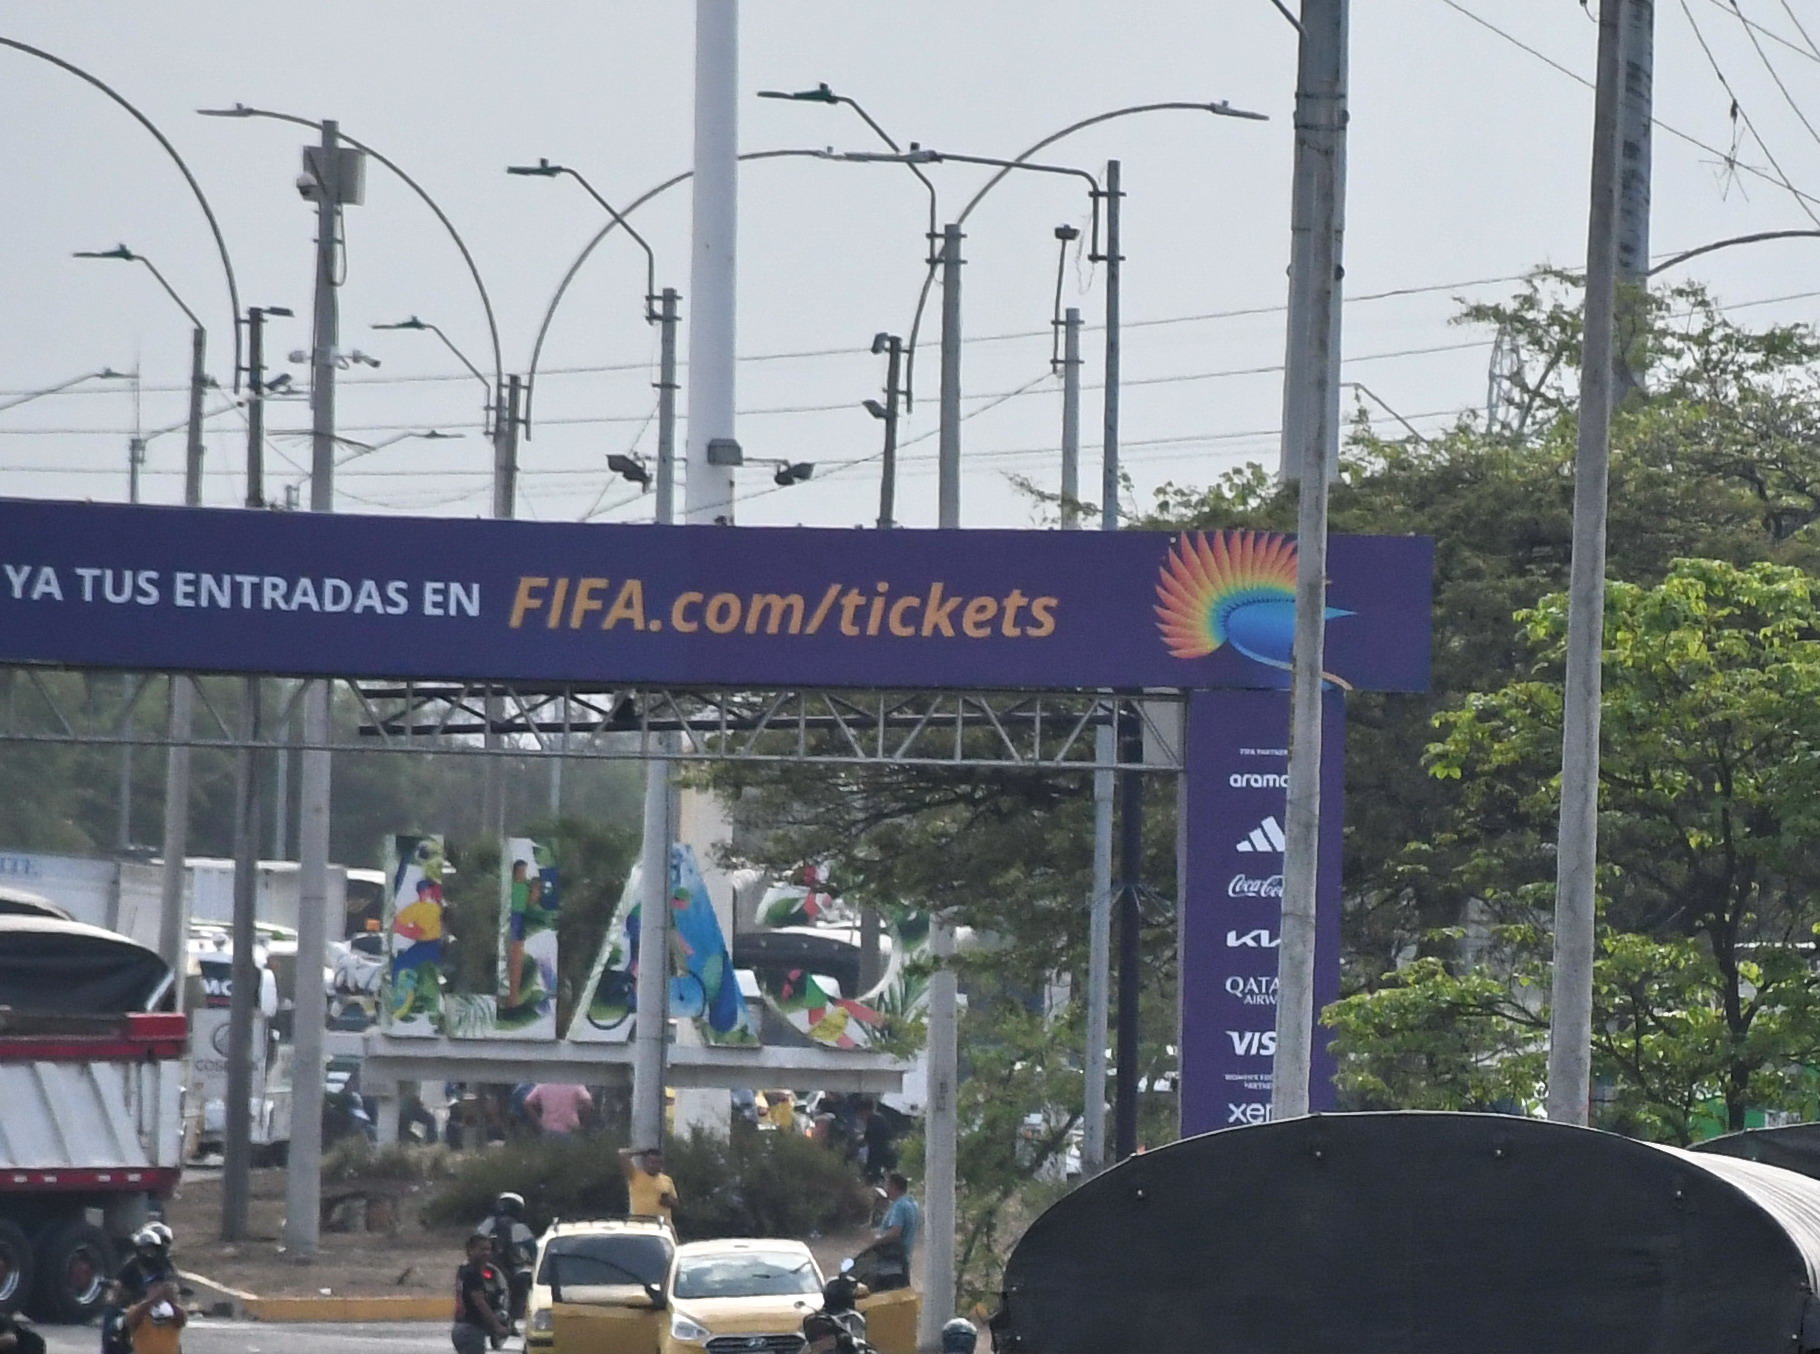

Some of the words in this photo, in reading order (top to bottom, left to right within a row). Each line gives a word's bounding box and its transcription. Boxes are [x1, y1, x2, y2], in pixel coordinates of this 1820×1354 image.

[3, 564, 63, 601] YA
[75, 567, 160, 606] TUS
[173, 572, 409, 615] ENTRADAS
[423, 582, 480, 617] EN
[508, 576, 1059, 638] FIFA.com/tickets
[1229, 773, 1289, 788] aramc
[1226, 929, 1282, 948] KI
[1225, 976, 1279, 998] QATA
[1243, 994, 1277, 1005] AIRW
[1225, 1031, 1277, 1056] VIS
[1228, 1103, 1273, 1124] xer
